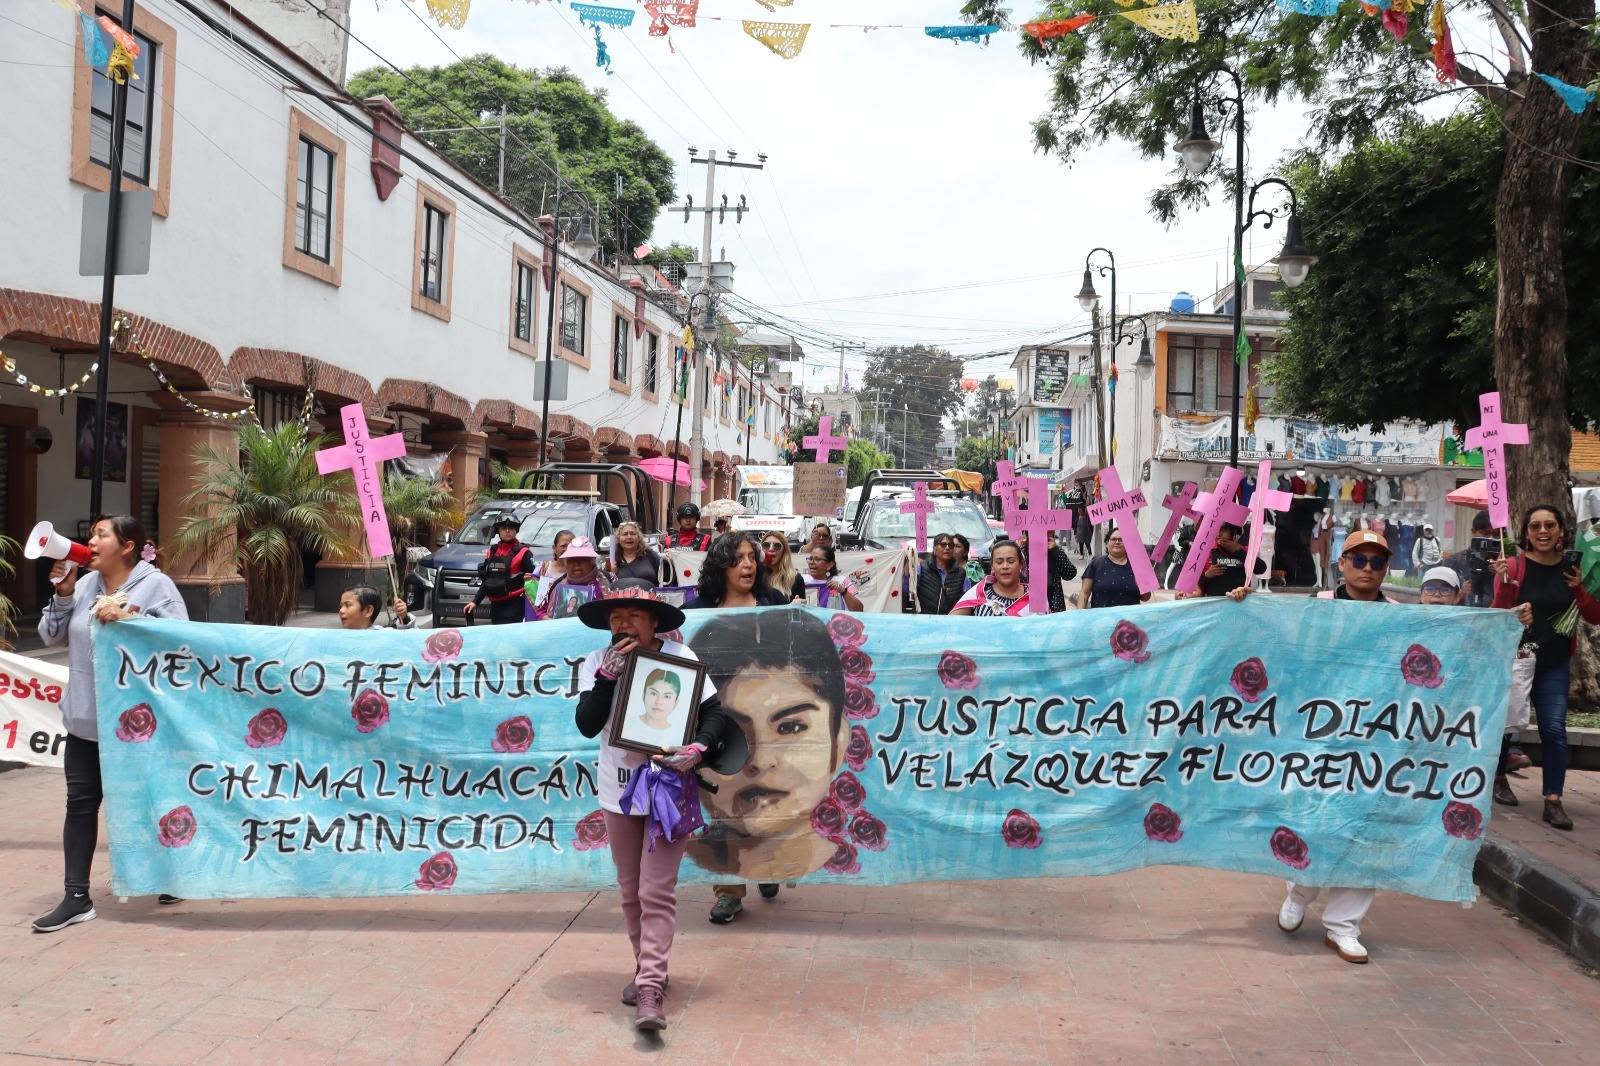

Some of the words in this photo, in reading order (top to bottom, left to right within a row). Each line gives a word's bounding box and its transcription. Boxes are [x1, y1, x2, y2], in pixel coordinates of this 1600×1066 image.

[1482, 429, 1498, 439] UNA
[1483, 405, 1495, 414] NI
[347, 417, 381, 523] JUSTICIA
[1487, 448, 1500, 506] MENOS
[511, 501, 566, 510] 1001
[1015, 514, 1057, 527] DIANA
[1091, 508, 1103, 517] NI
[1107, 499, 1129, 513] UNA
[1189, 484, 1230, 573] JUSTICIA
[117, 646, 326, 697] MÉXICO
[878, 694, 1128, 744] JUSTICIA
[1147, 695, 1278, 736] PARA
[1298, 700, 1481, 749] DIANA
[188, 754, 598, 801] CHIMALHUACÁN
[878, 742, 1169, 794] VELÁZQUEZ
[1178, 744, 1488, 800] FLORENCIO
[242, 811, 561, 861] FEMINICIDA
